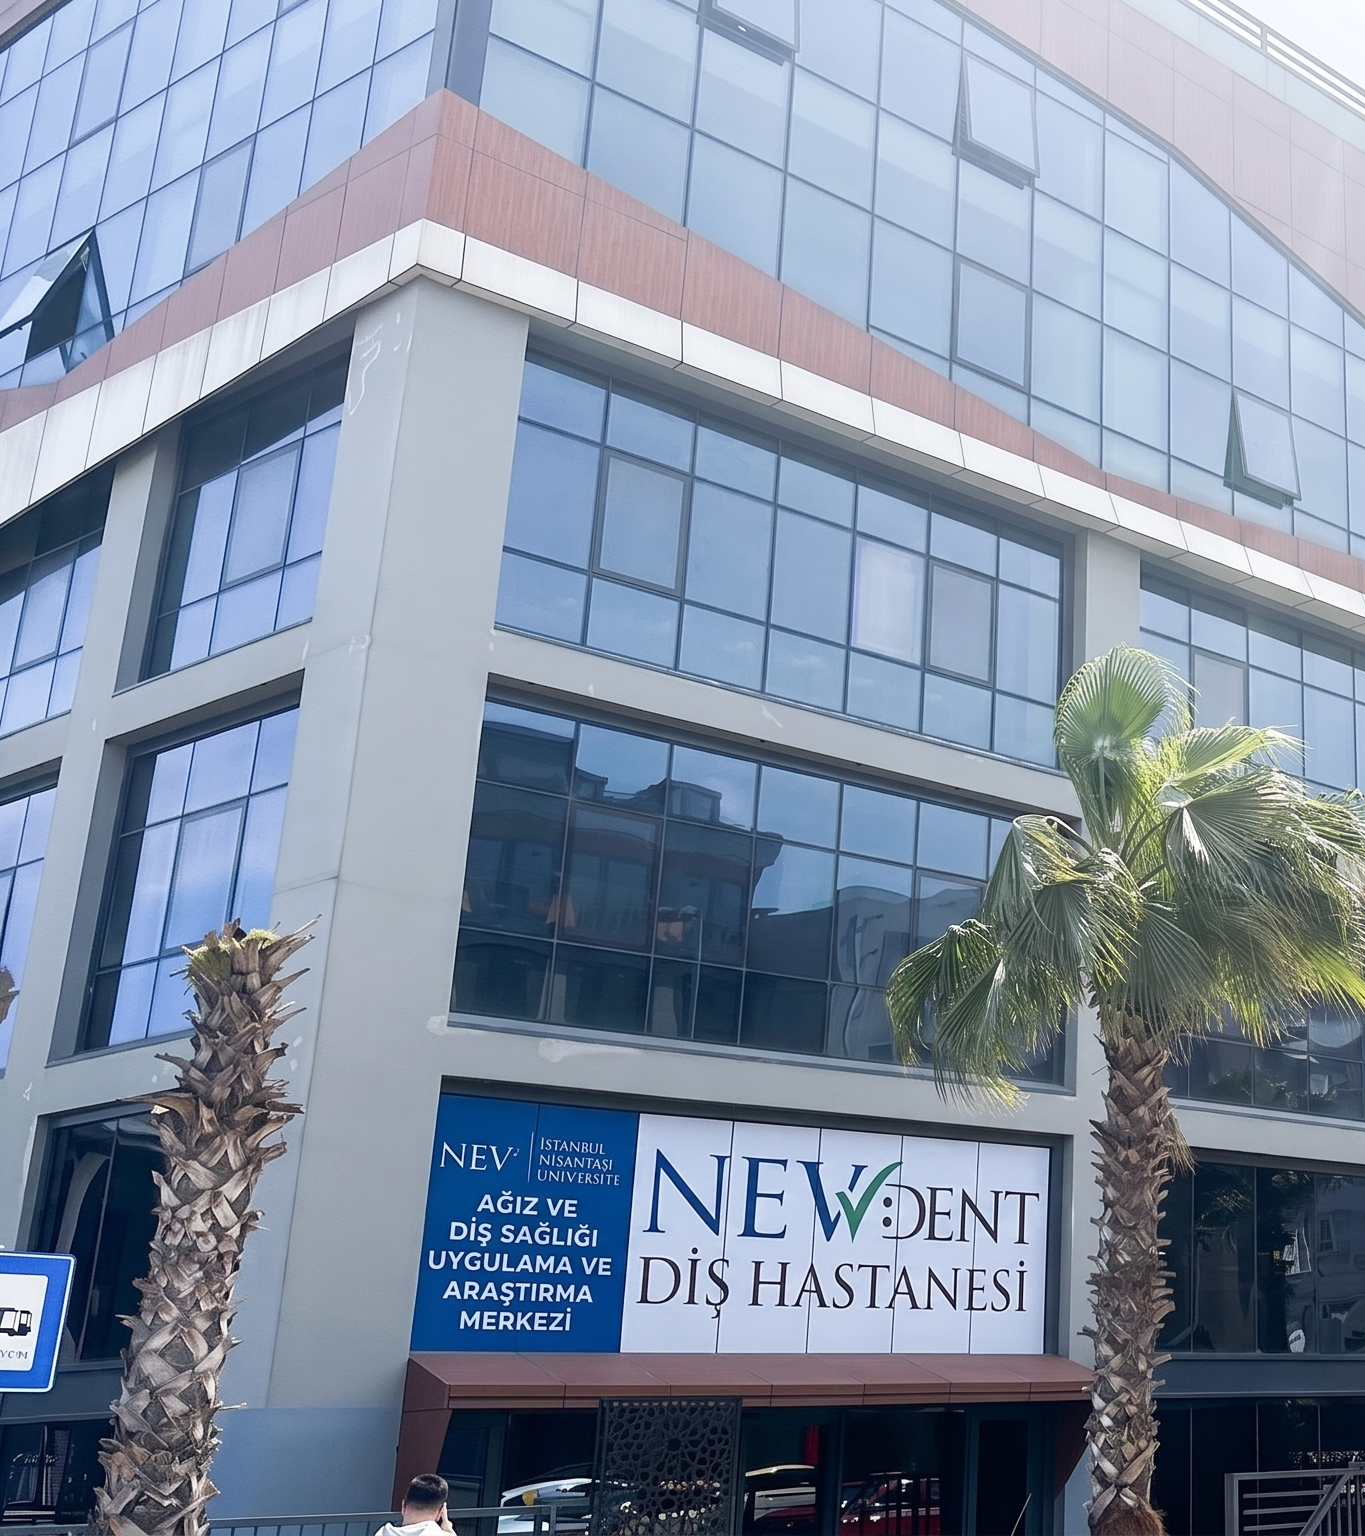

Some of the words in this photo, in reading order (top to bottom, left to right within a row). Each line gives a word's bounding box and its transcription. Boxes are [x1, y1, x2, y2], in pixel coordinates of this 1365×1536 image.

[477, 1190, 539, 1216] AĞIZ
[546, 1198, 578, 1218] VE
[449, 1216, 492, 1247] DİŞ
[500, 1221, 598, 1247] SAĞLIĞI
[428, 1250, 573, 1275] UYGULAMA
[581, 1256, 612, 1276] VE
[442, 1280, 593, 1307] ARAŞTIRMA
[636, 1247, 730, 1319] DİŞ
[748, 1260, 1028, 1312] HASTANESİ
[459, 1307, 572, 1331] MERKEZİ
